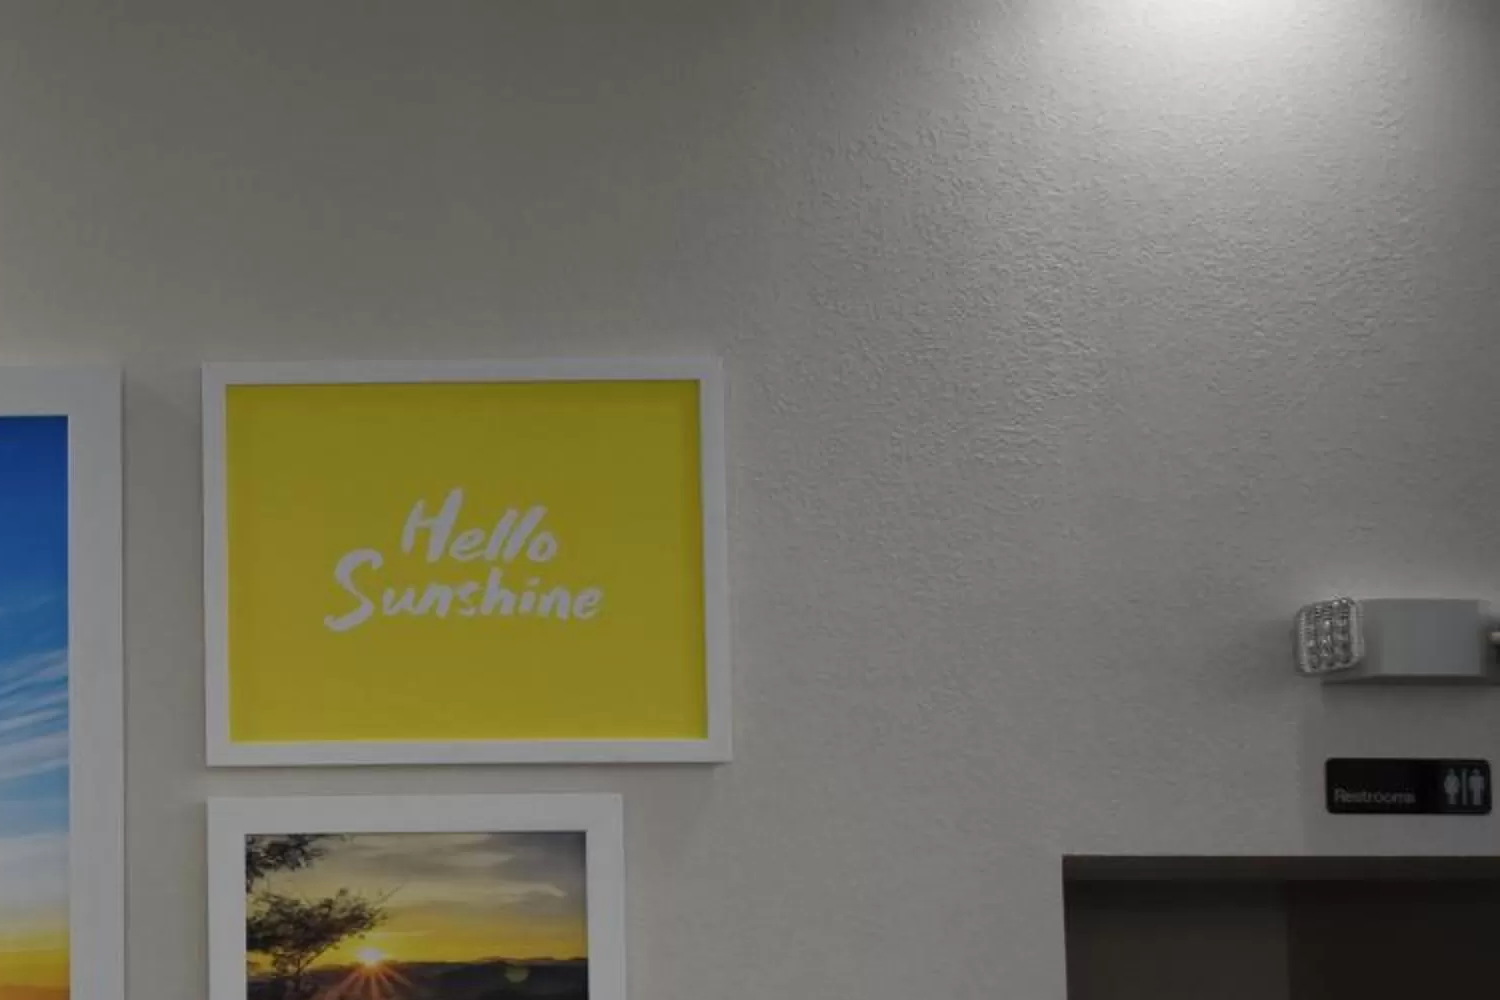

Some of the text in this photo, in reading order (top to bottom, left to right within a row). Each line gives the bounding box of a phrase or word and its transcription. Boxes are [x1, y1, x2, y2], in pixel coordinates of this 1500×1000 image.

[401, 486, 559, 562] Hello
[322, 548, 604, 632] Sunshine
[1332, 786, 1417, 804] Restrooms
